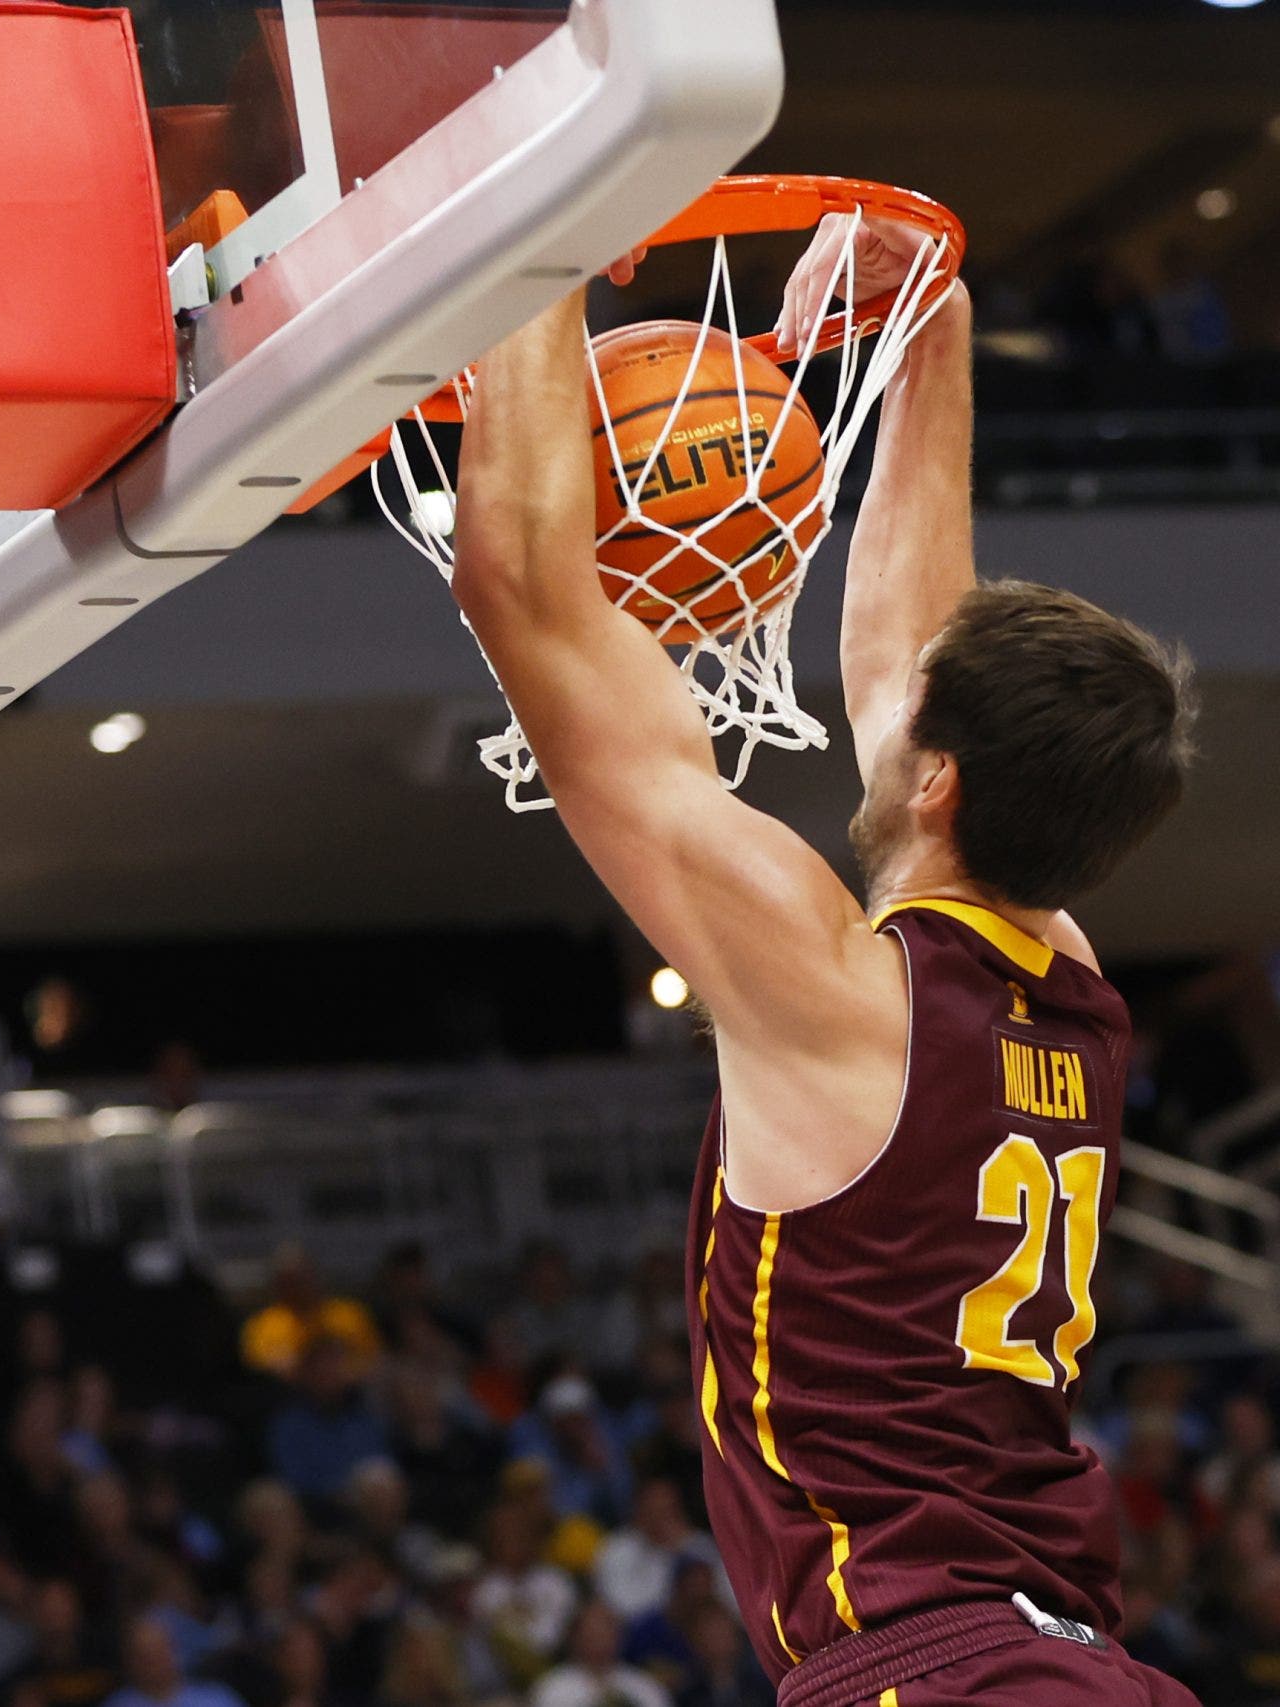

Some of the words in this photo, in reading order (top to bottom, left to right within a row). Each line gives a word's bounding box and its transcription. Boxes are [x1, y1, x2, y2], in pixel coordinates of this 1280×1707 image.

[610, 428, 776, 508] ELITE
[1000, 1038, 1087, 1120] MULLEN
[954, 1132, 1106, 1393] 21
